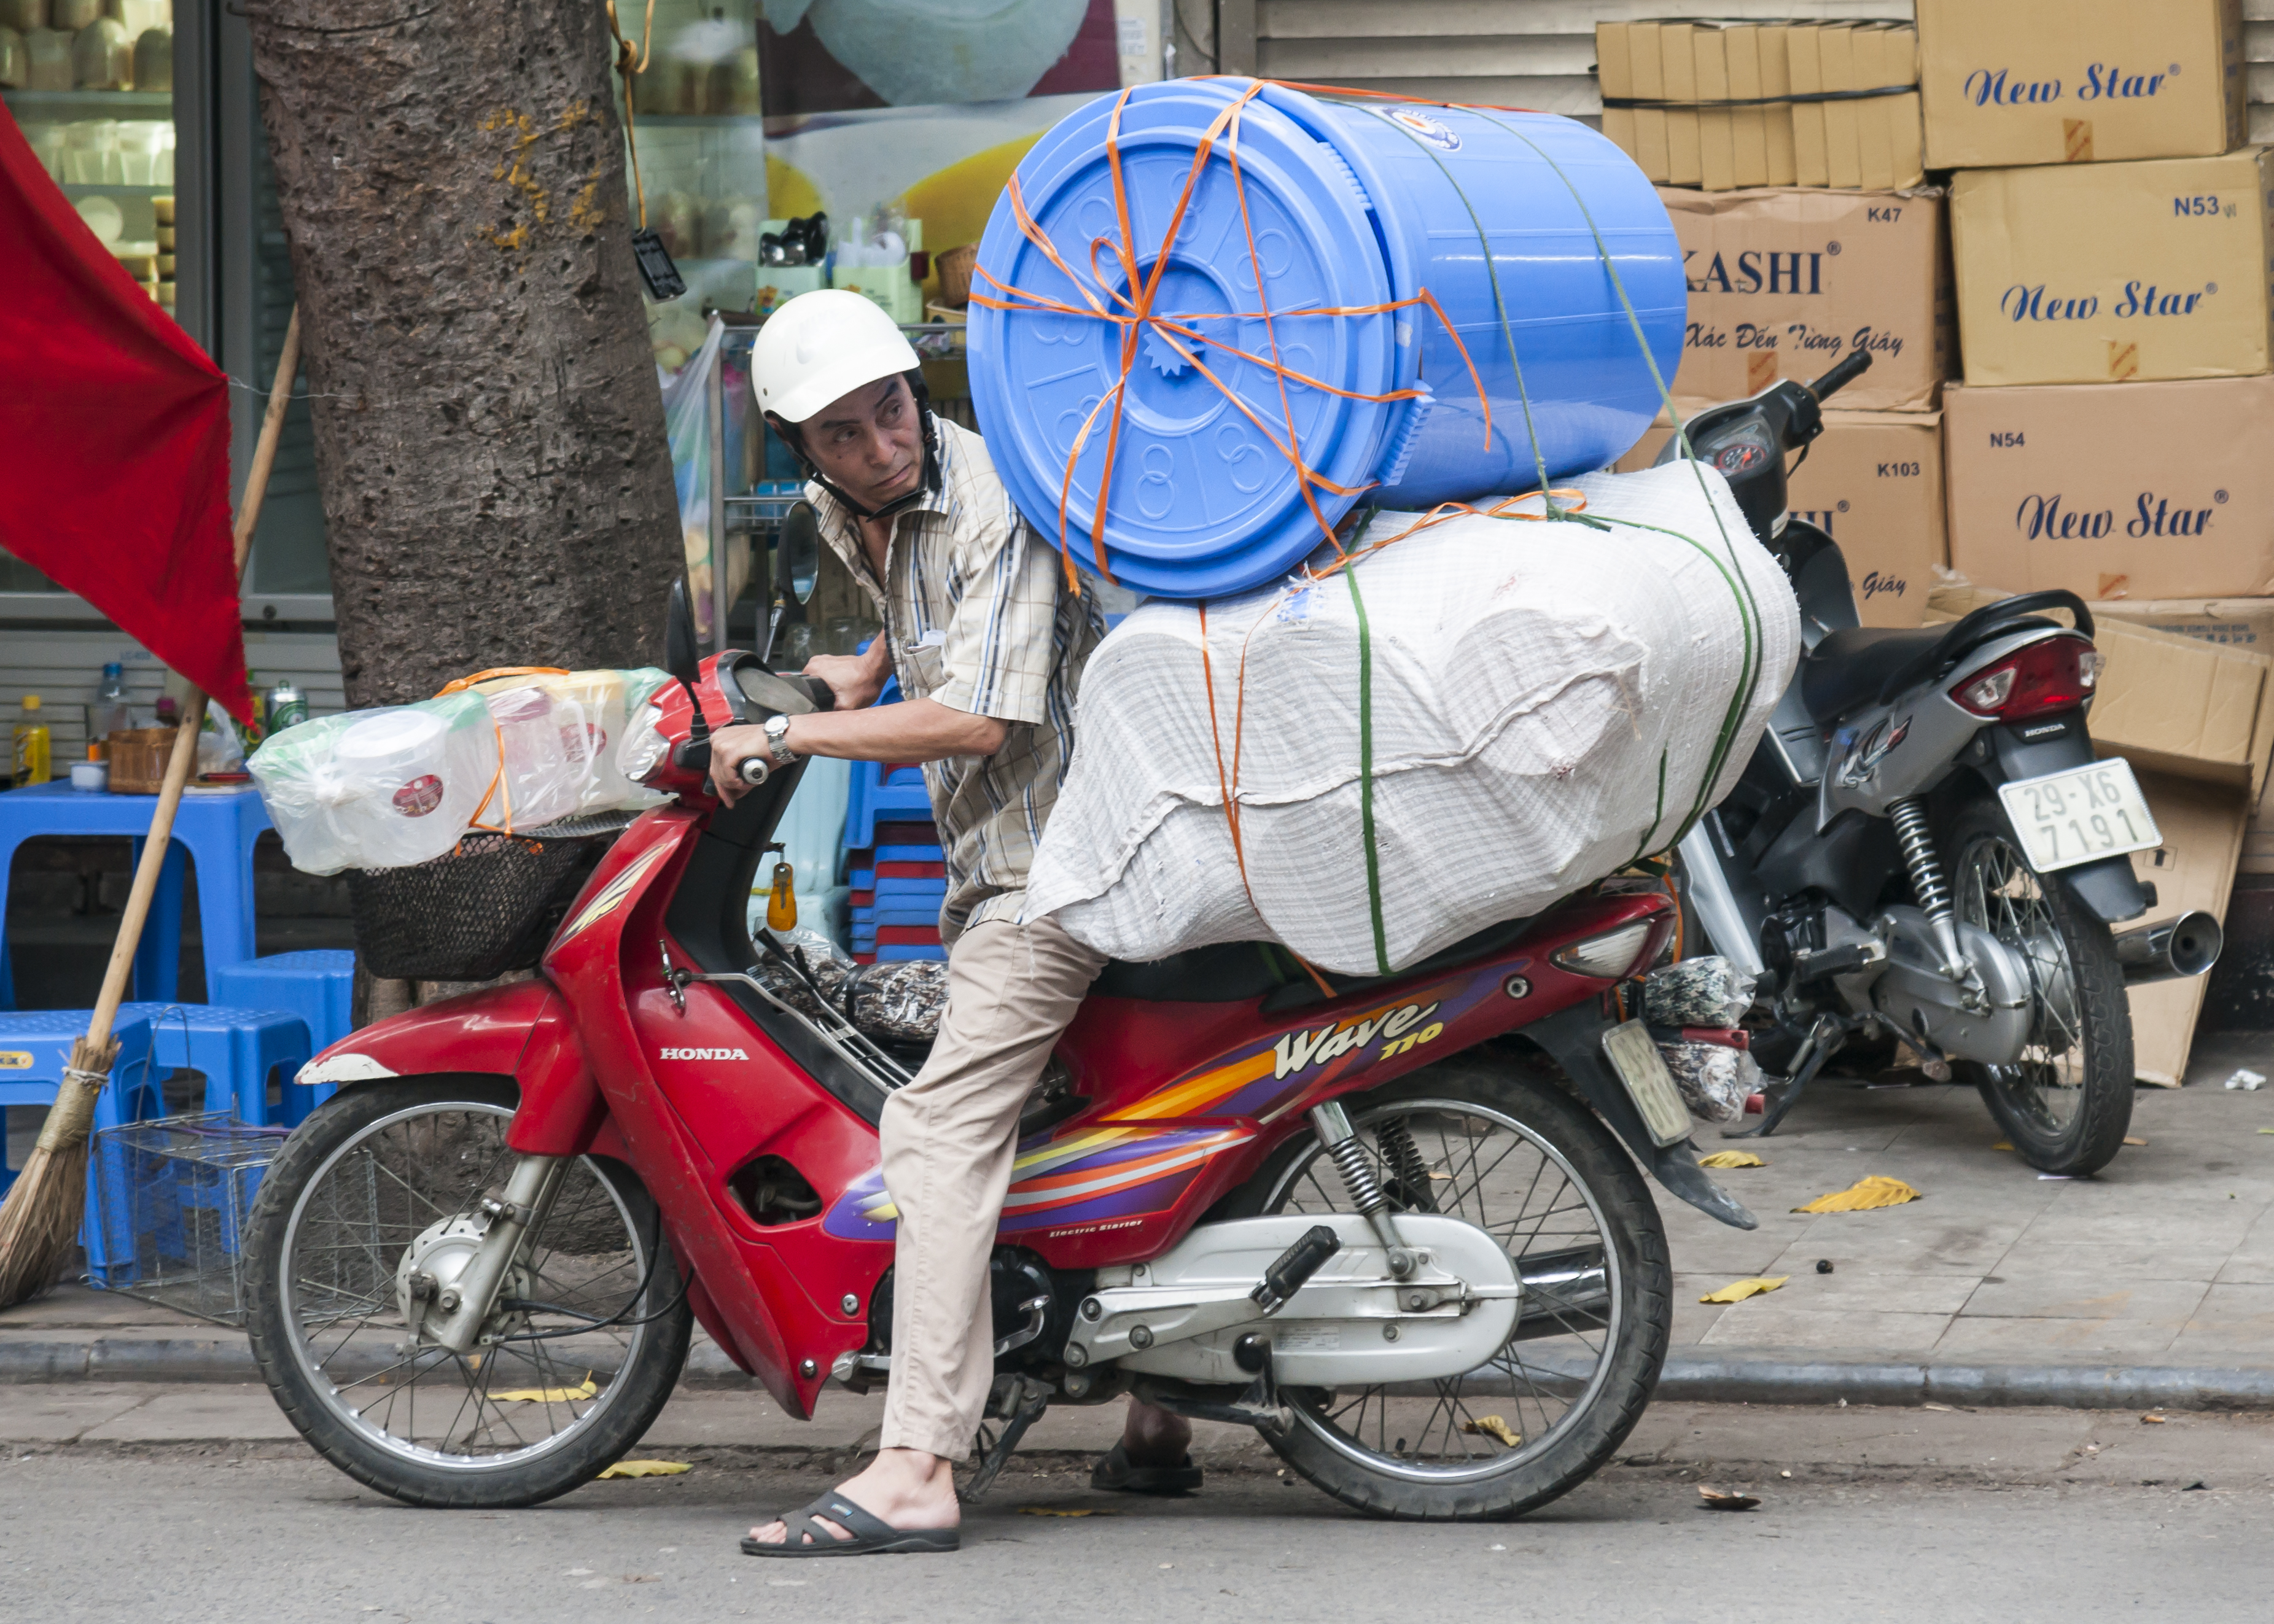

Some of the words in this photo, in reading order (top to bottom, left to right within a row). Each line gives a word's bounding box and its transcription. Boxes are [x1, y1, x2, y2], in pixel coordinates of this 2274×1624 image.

[1964, 68, 2064, 107] New
[1868, 208, 1902, 223] K47
[2174, 195, 2219, 217] N53
[2000, 284, 2101, 322] New
[1990, 432, 2025, 448] N54
[1877, 462, 1920, 477] K103
[2017, 494, 2116, 540] New
[2025, 723, 2065, 737] HONDA
[2039, 808, 2138, 862] 7191
[1274, 1001, 1441, 1081] Wave
[1379, 1022, 1444, 1061] 110
[660, 1047, 750, 1060] HONDA
[1049, 1227, 1096, 1238] Electric
[1099, 1220, 1142, 1232] Starter
